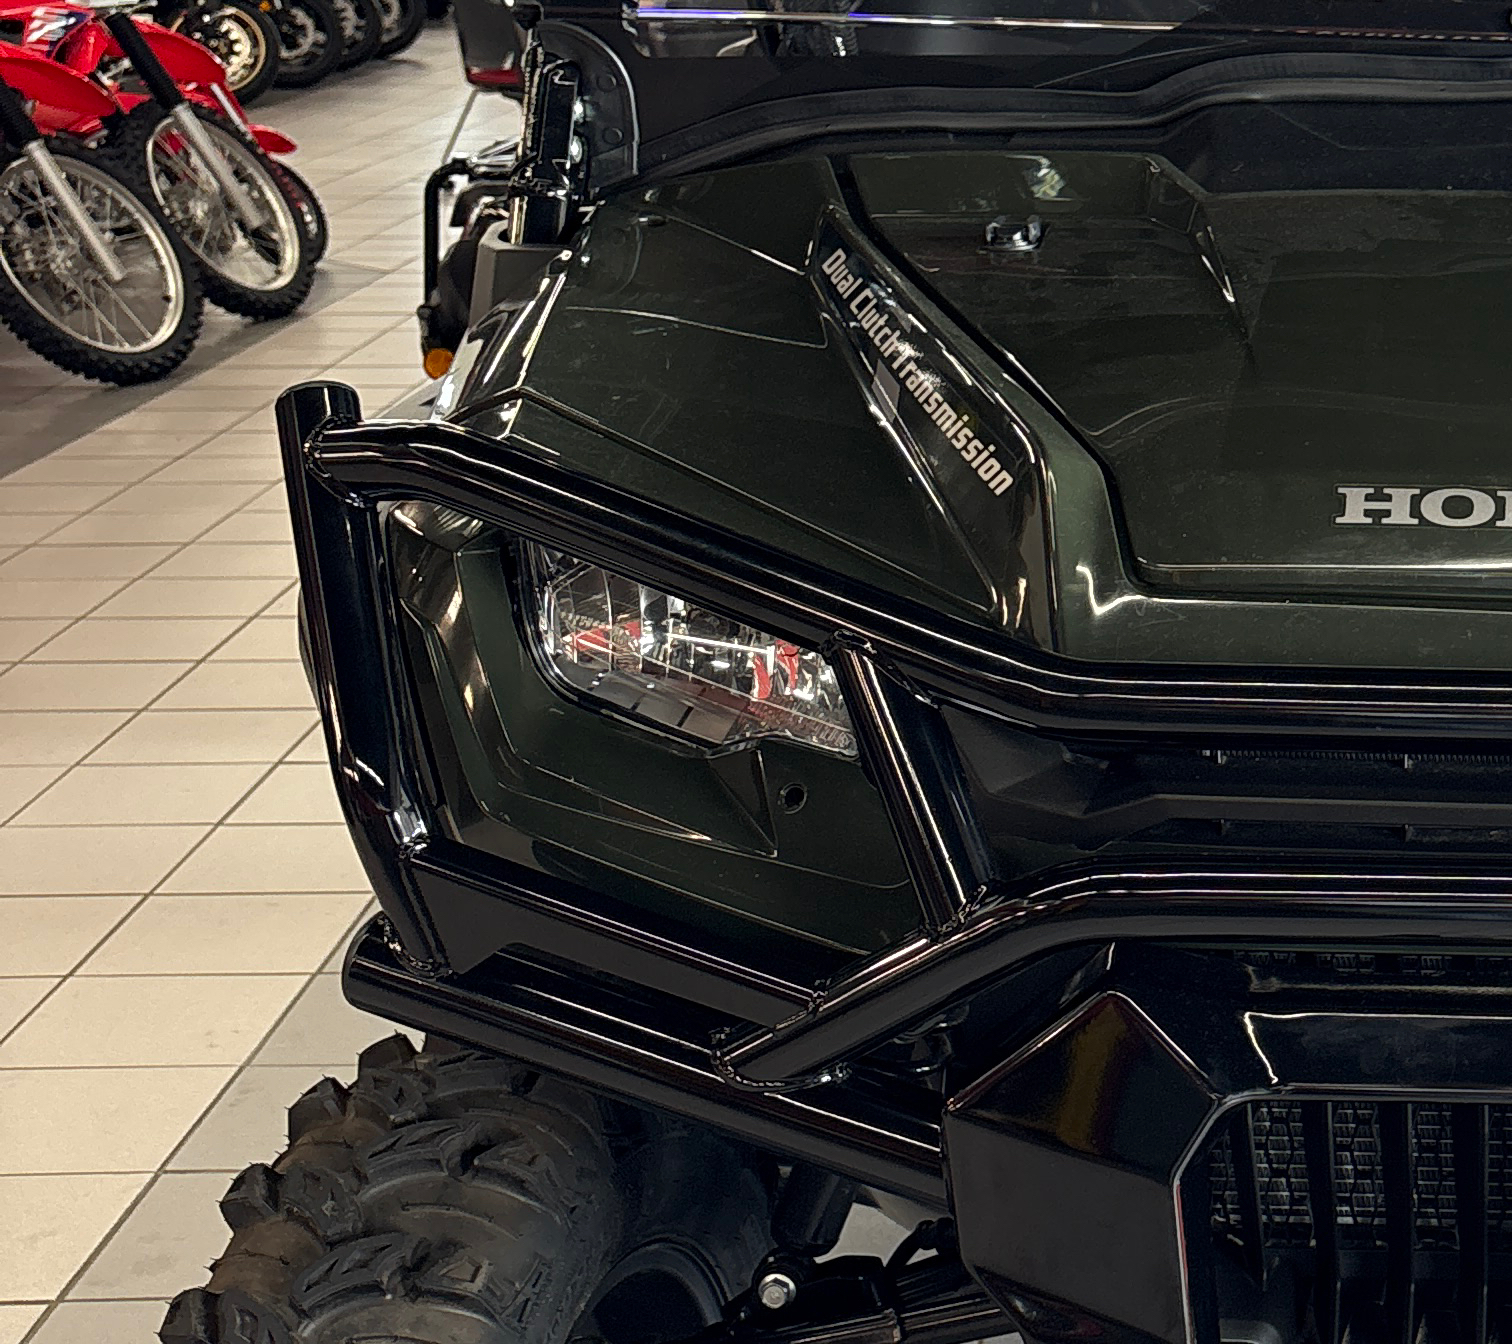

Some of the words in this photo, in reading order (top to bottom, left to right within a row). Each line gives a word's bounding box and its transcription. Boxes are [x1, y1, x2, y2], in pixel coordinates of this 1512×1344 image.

[821, 248, 863, 300] Dual
[850, 287, 900, 359] Clutch
[891, 352, 1014, 496] Transmission
